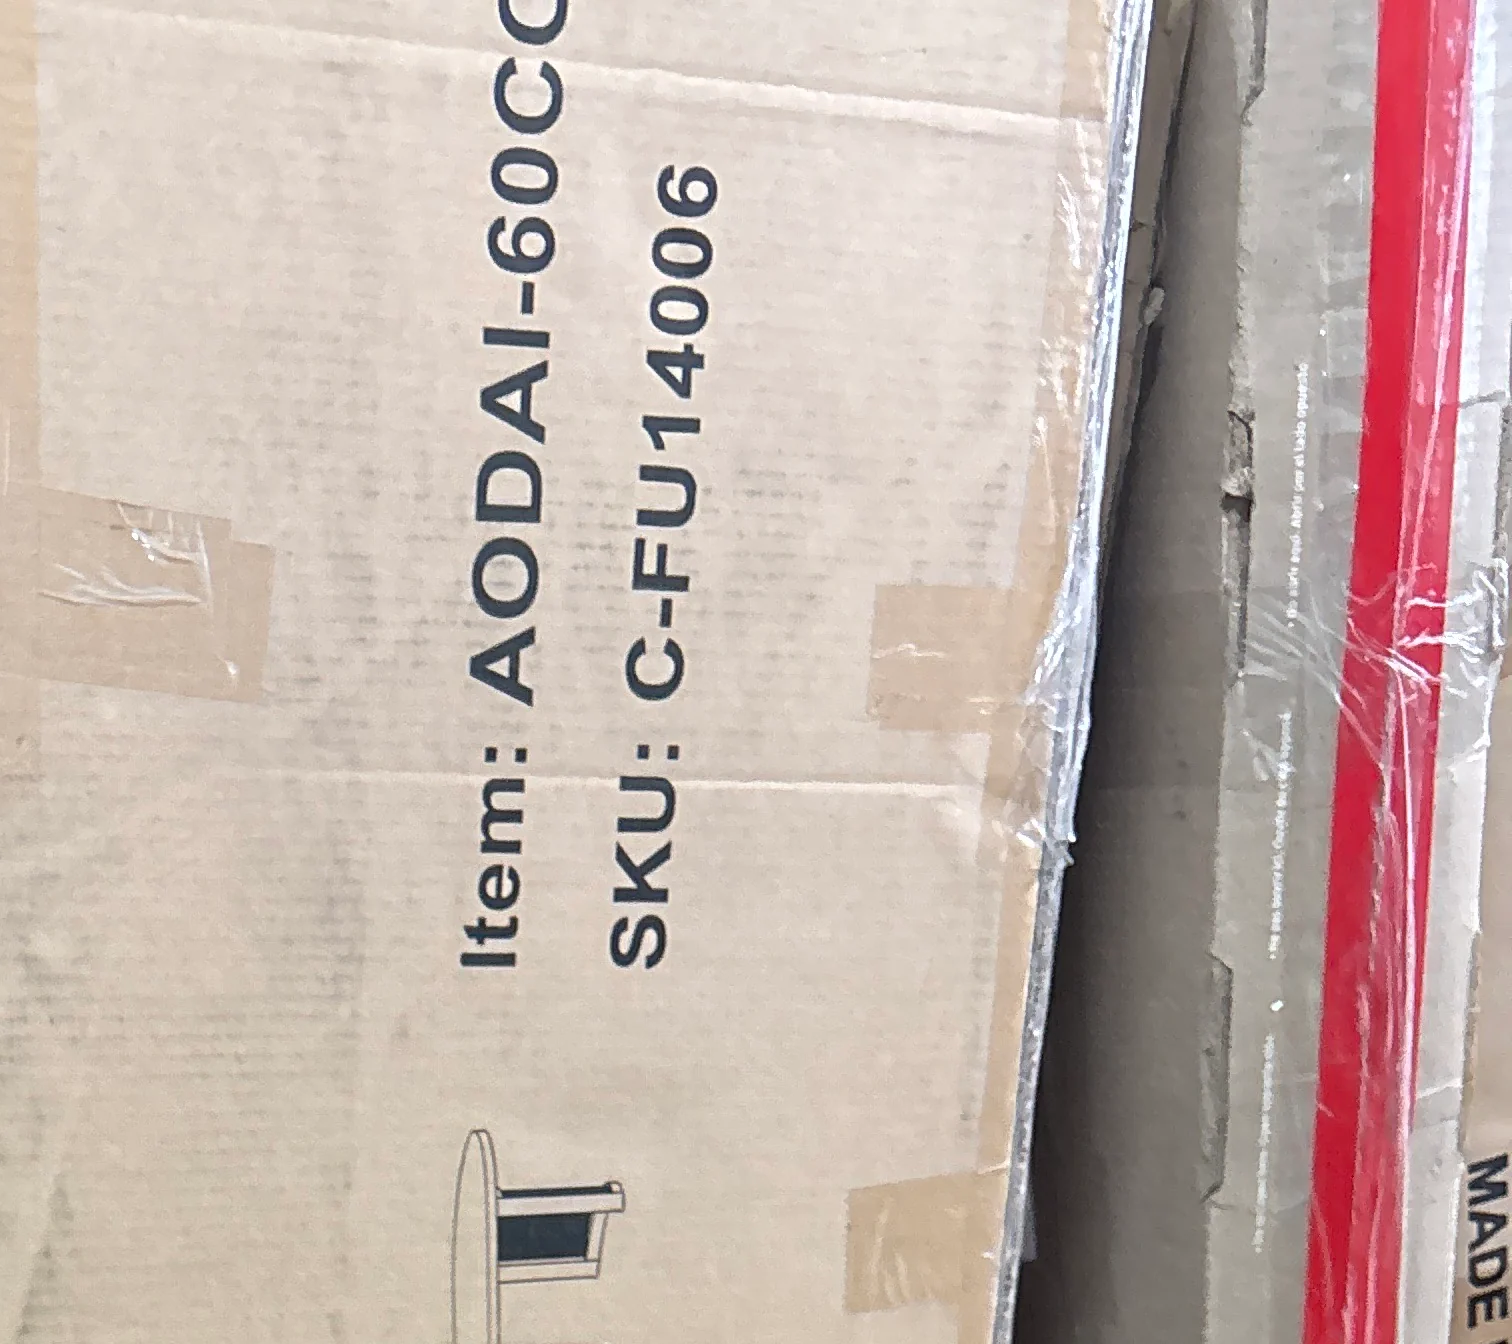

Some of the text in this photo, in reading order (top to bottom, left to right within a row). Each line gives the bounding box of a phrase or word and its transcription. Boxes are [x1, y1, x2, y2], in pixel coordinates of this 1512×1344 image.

[609, 165, 718, 970] SKU: C-FU14006
[459, 746, 532, 968] Item:
[1466, 1153, 1509, 1331] MADE
